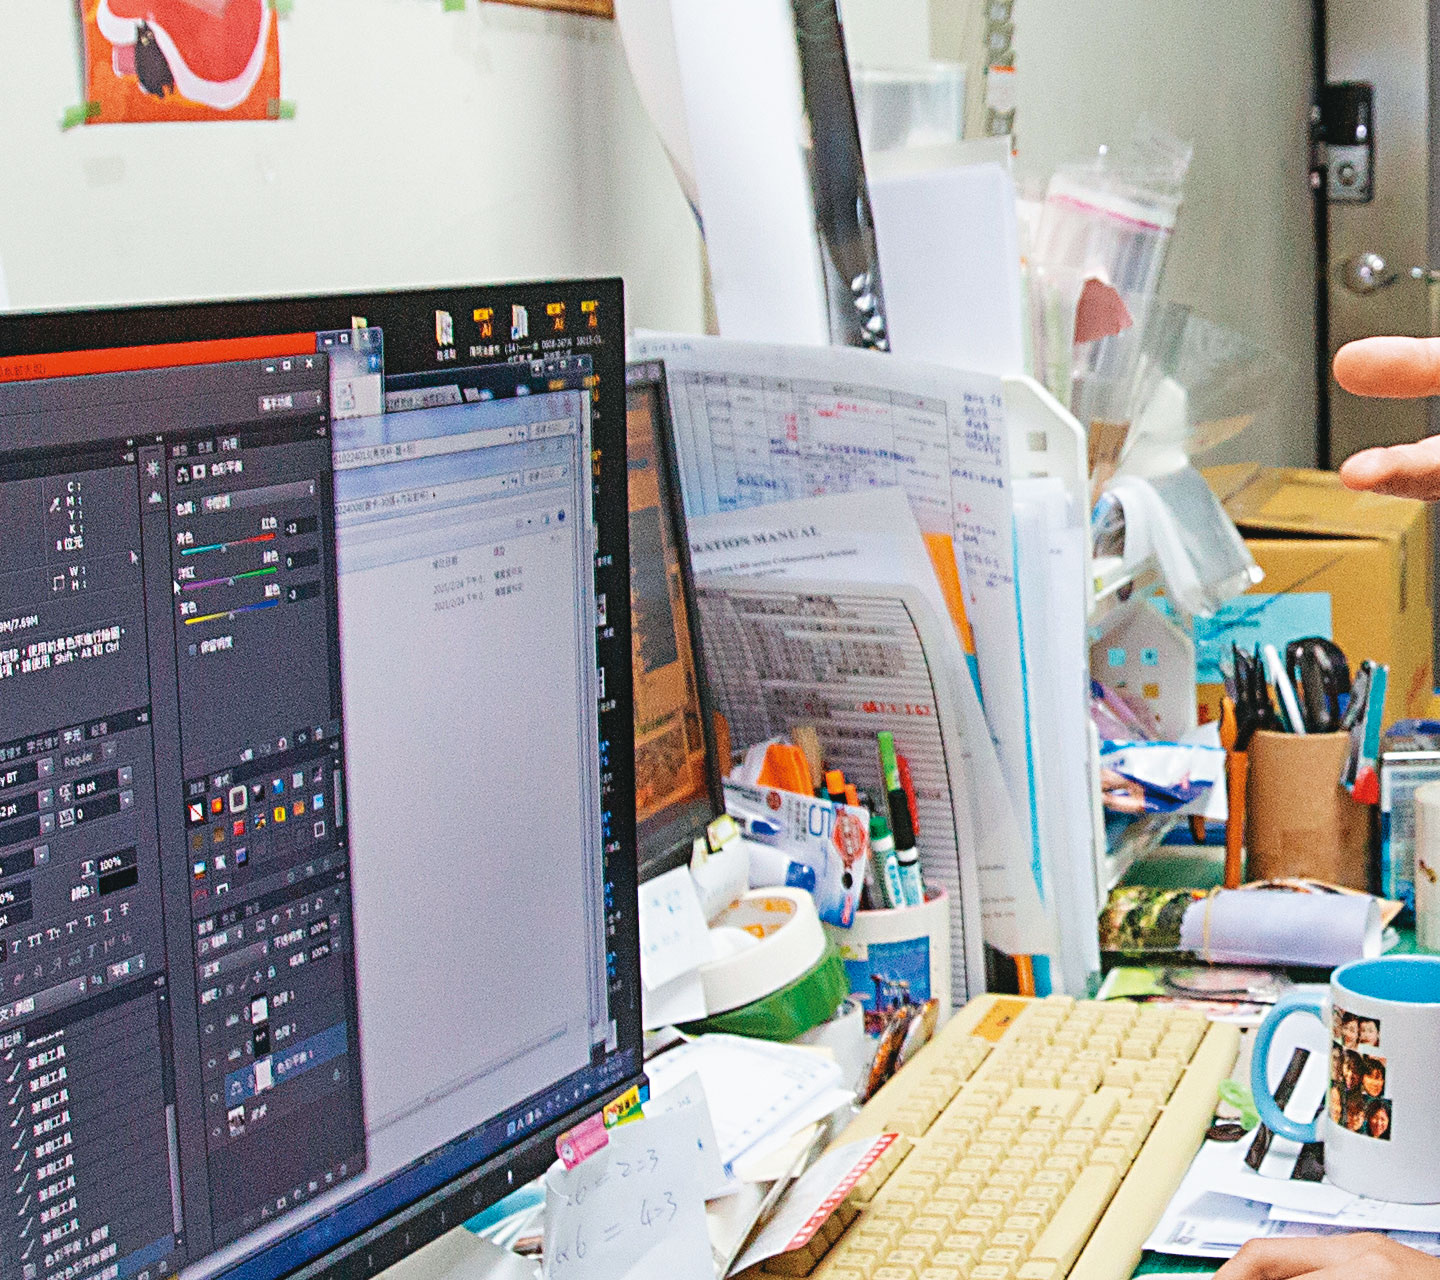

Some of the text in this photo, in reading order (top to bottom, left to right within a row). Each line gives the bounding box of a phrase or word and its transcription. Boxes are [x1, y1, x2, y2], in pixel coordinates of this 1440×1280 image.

[6, 770, 19, 785] BT
[76, 784, 87, 796] 18
[99, 855, 123, 871] 100%
